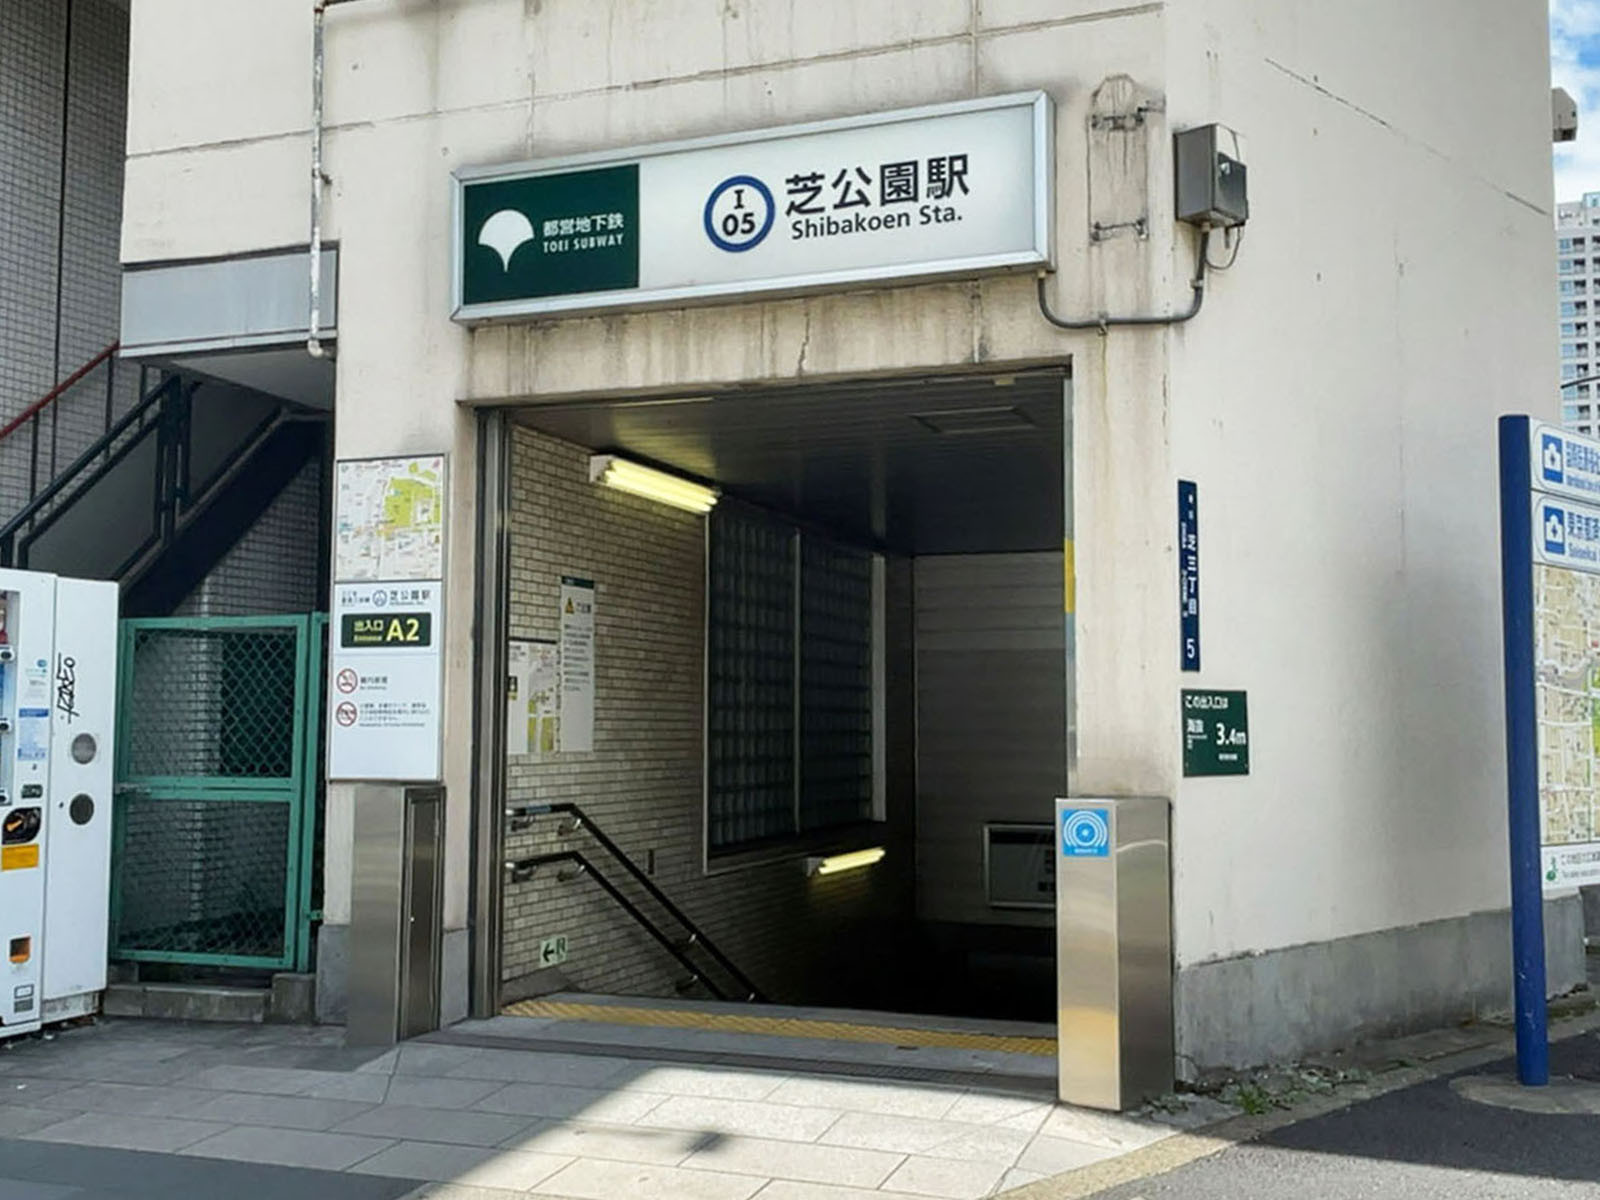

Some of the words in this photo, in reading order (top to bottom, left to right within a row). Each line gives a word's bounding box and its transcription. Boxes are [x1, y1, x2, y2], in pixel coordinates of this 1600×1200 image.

[785, 153, 970, 217] 芝公園駅
[733, 188, 744, 210] I
[543, 212, 624, 237] 都営地下鉄
[722, 212, 756, 236] 05
[791, 212, 911, 240] Shibakoen
[919, 204, 963, 226] Sta.
[543, 239, 569, 254] TOEI
[573, 233, 624, 250] SUBWAY
[386, 618, 420, 642] A2
[1186, 638, 1196, 659] 5
[1216, 722, 1247, 746] 3.4m
